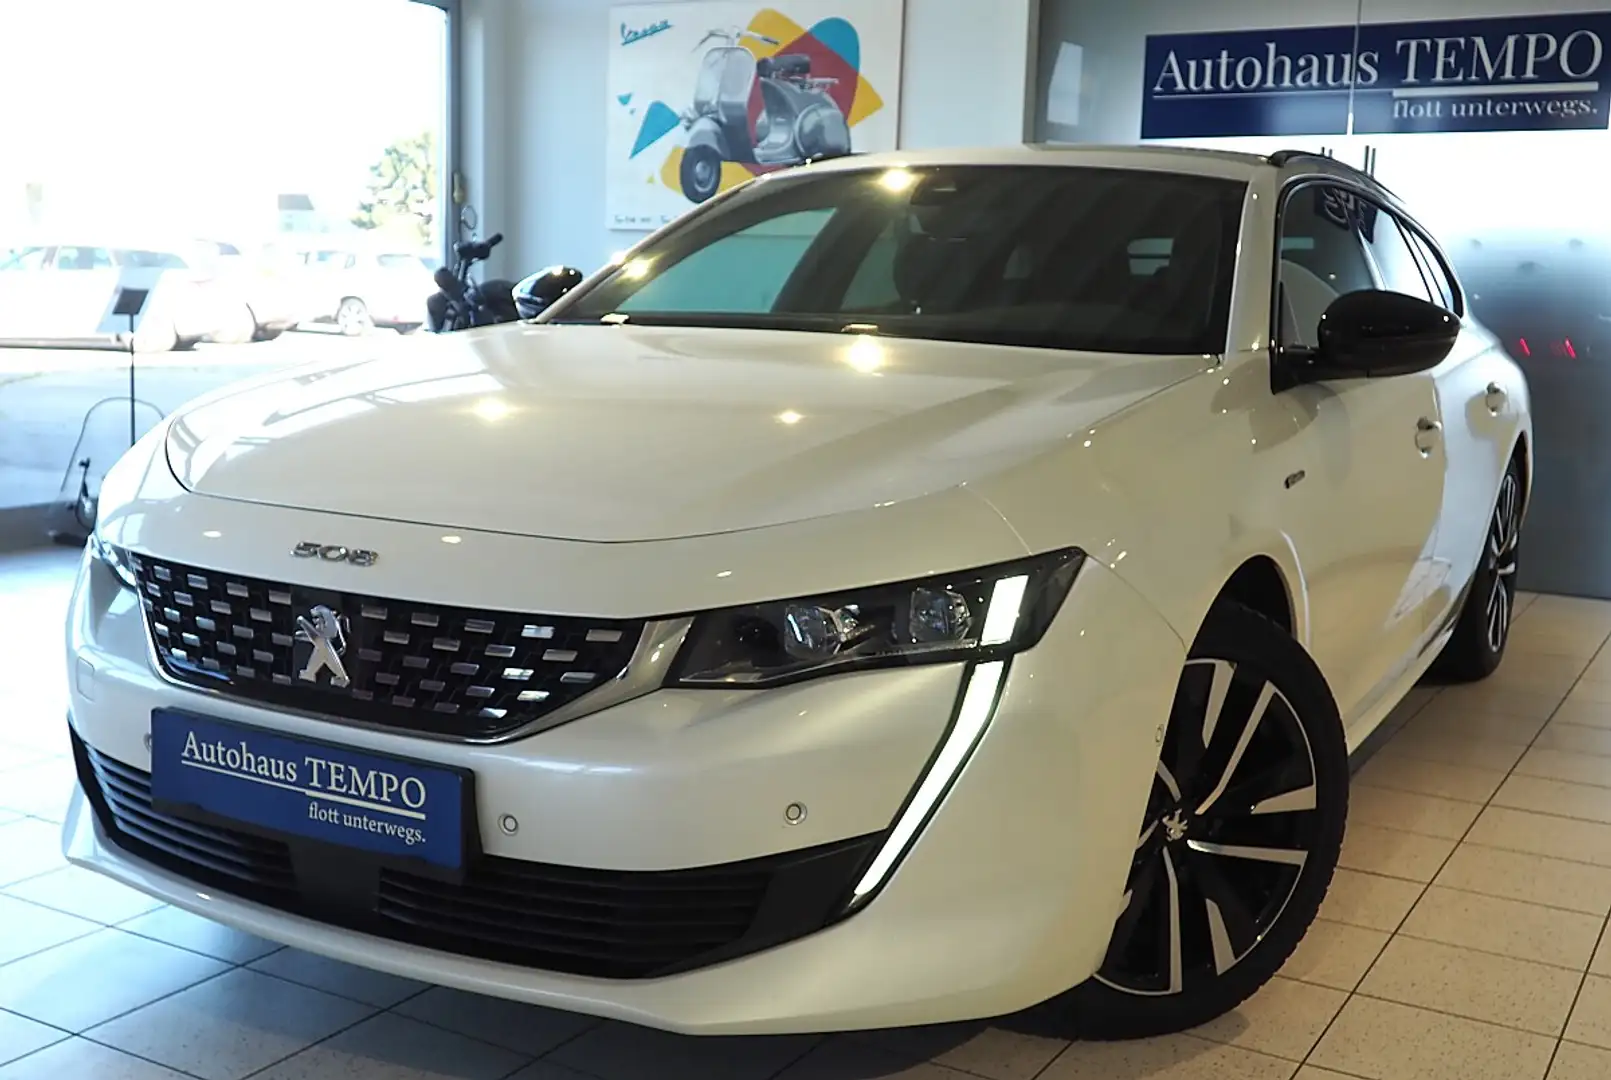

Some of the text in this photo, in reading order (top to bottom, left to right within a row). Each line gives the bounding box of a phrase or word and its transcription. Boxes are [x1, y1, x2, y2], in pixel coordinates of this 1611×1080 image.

[1152, 30, 1603, 92] Autohaus TEMPO
[1393, 99, 1599, 119] flott unterwegs.
[289, 541, 379, 567] 508
[181, 731, 426, 809] Autohaus TEMPO
[308, 801, 427, 846] flott unterwegs.
